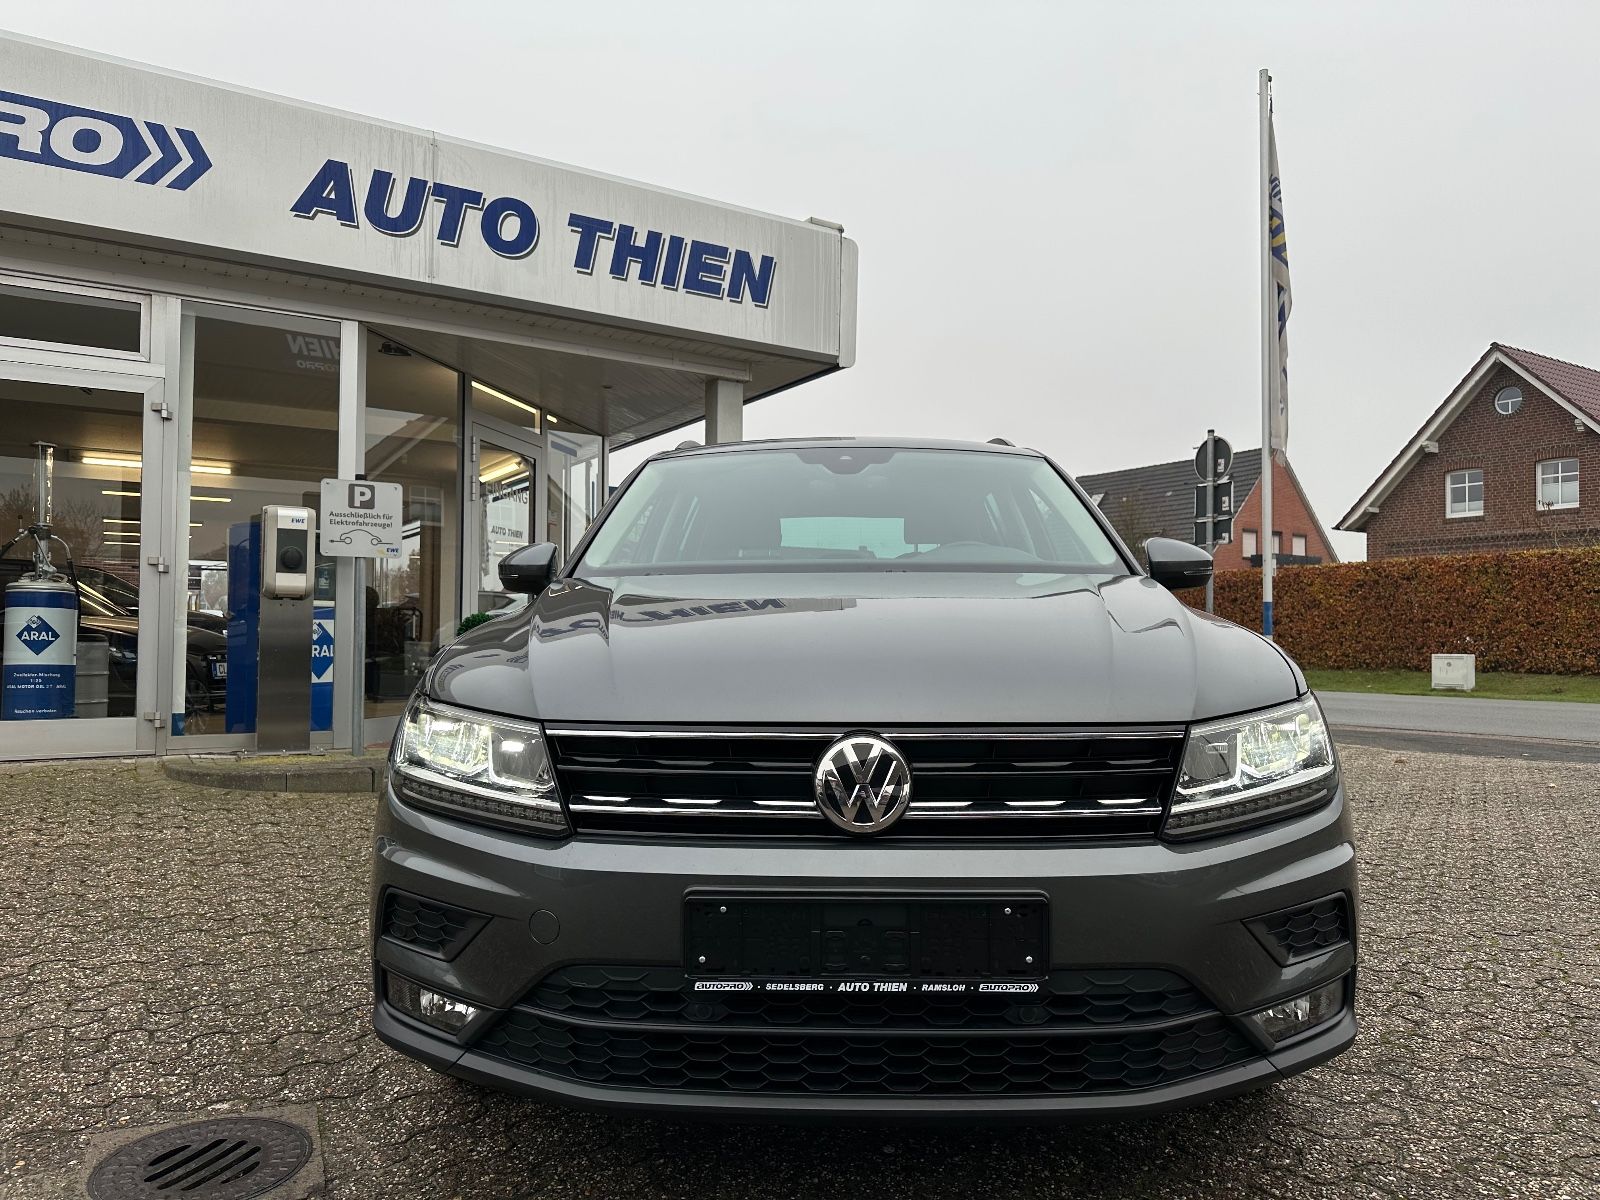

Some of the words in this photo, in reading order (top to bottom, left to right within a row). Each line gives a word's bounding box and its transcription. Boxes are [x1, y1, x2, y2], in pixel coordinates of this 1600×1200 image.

[289, 158, 540, 261] AUTO
[568, 212, 777, 309] THIEN
[353, 486, 372, 507] P
[329, 511, 382, 520] Ausschließlich
[383, 513, 394, 521] für
[490, 525, 507, 536] AUTO
[508, 528, 524, 540] THIEN
[21, 631, 56, 641] ARAL
[765, 983, 825, 991] SEDELSBERG
[837, 982, 870, 992] AUTO
[872, 982, 908, 992] THIEN
[921, 984, 966, 992] RAMSLOH
